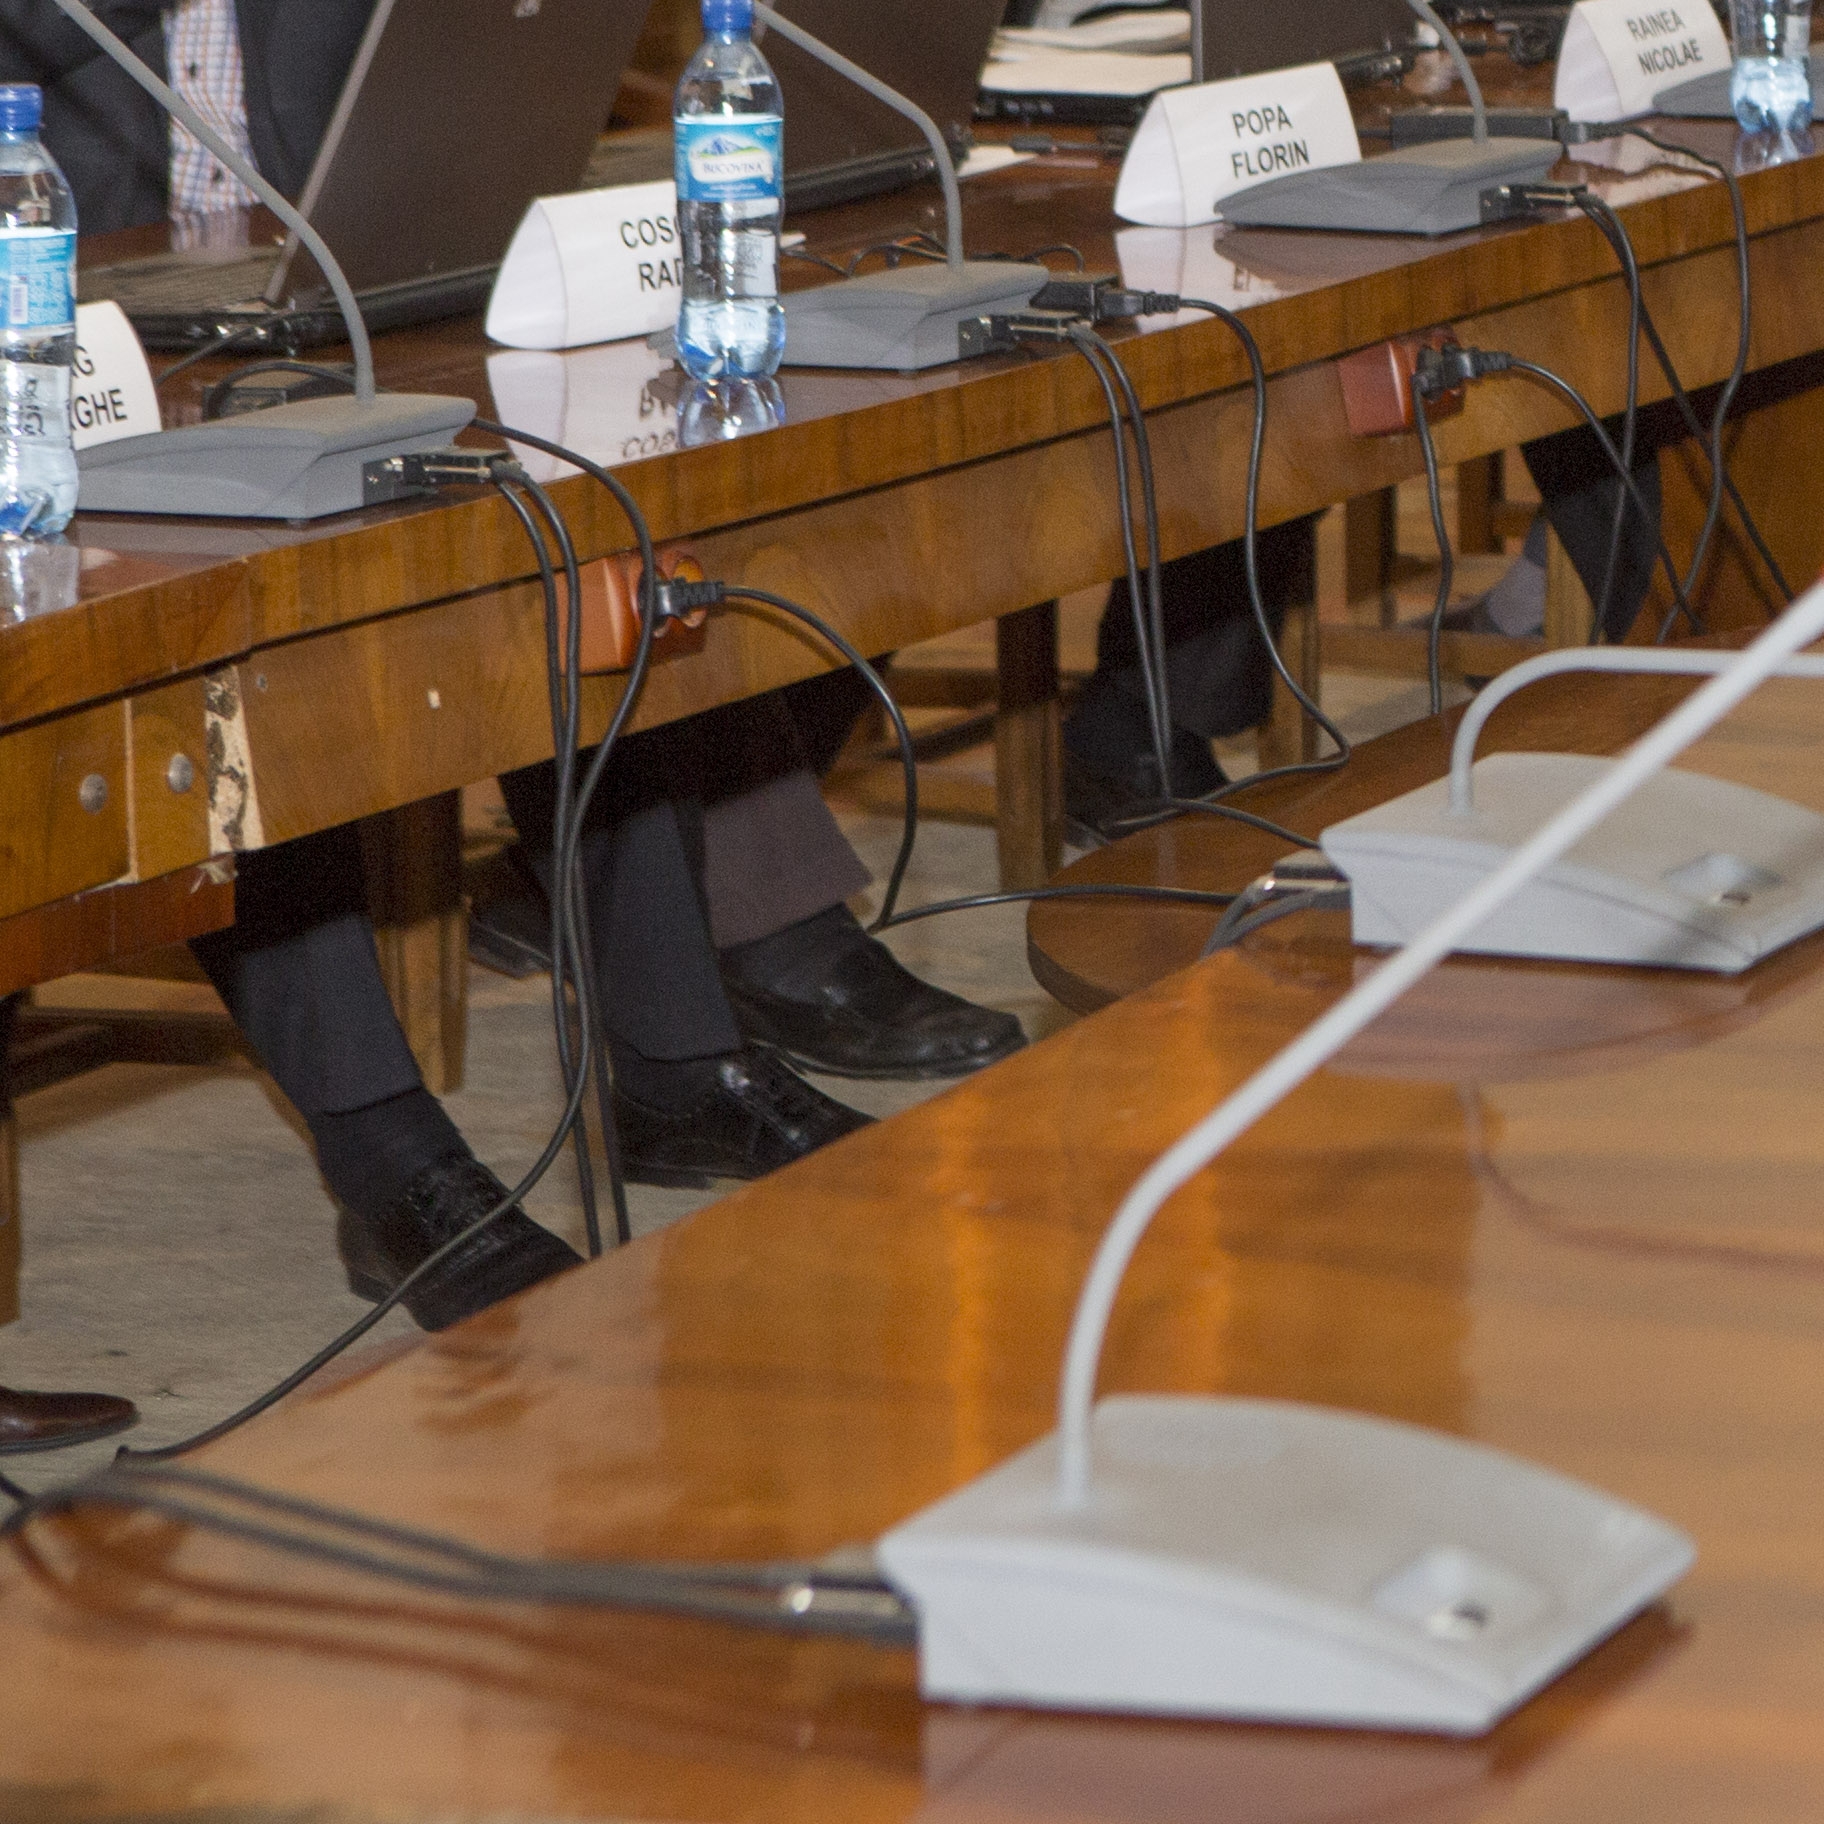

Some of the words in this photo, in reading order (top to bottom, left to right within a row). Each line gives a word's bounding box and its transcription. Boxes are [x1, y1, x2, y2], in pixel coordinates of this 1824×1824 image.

[1626, 8, 1685, 41] RAINEA
[1637, 38, 1703, 74] NICOLAE
[1231, 104, 1293, 138] POPA
[1231, 138, 1310, 178] FLORIN
[72, 388, 128, 431] GHE
